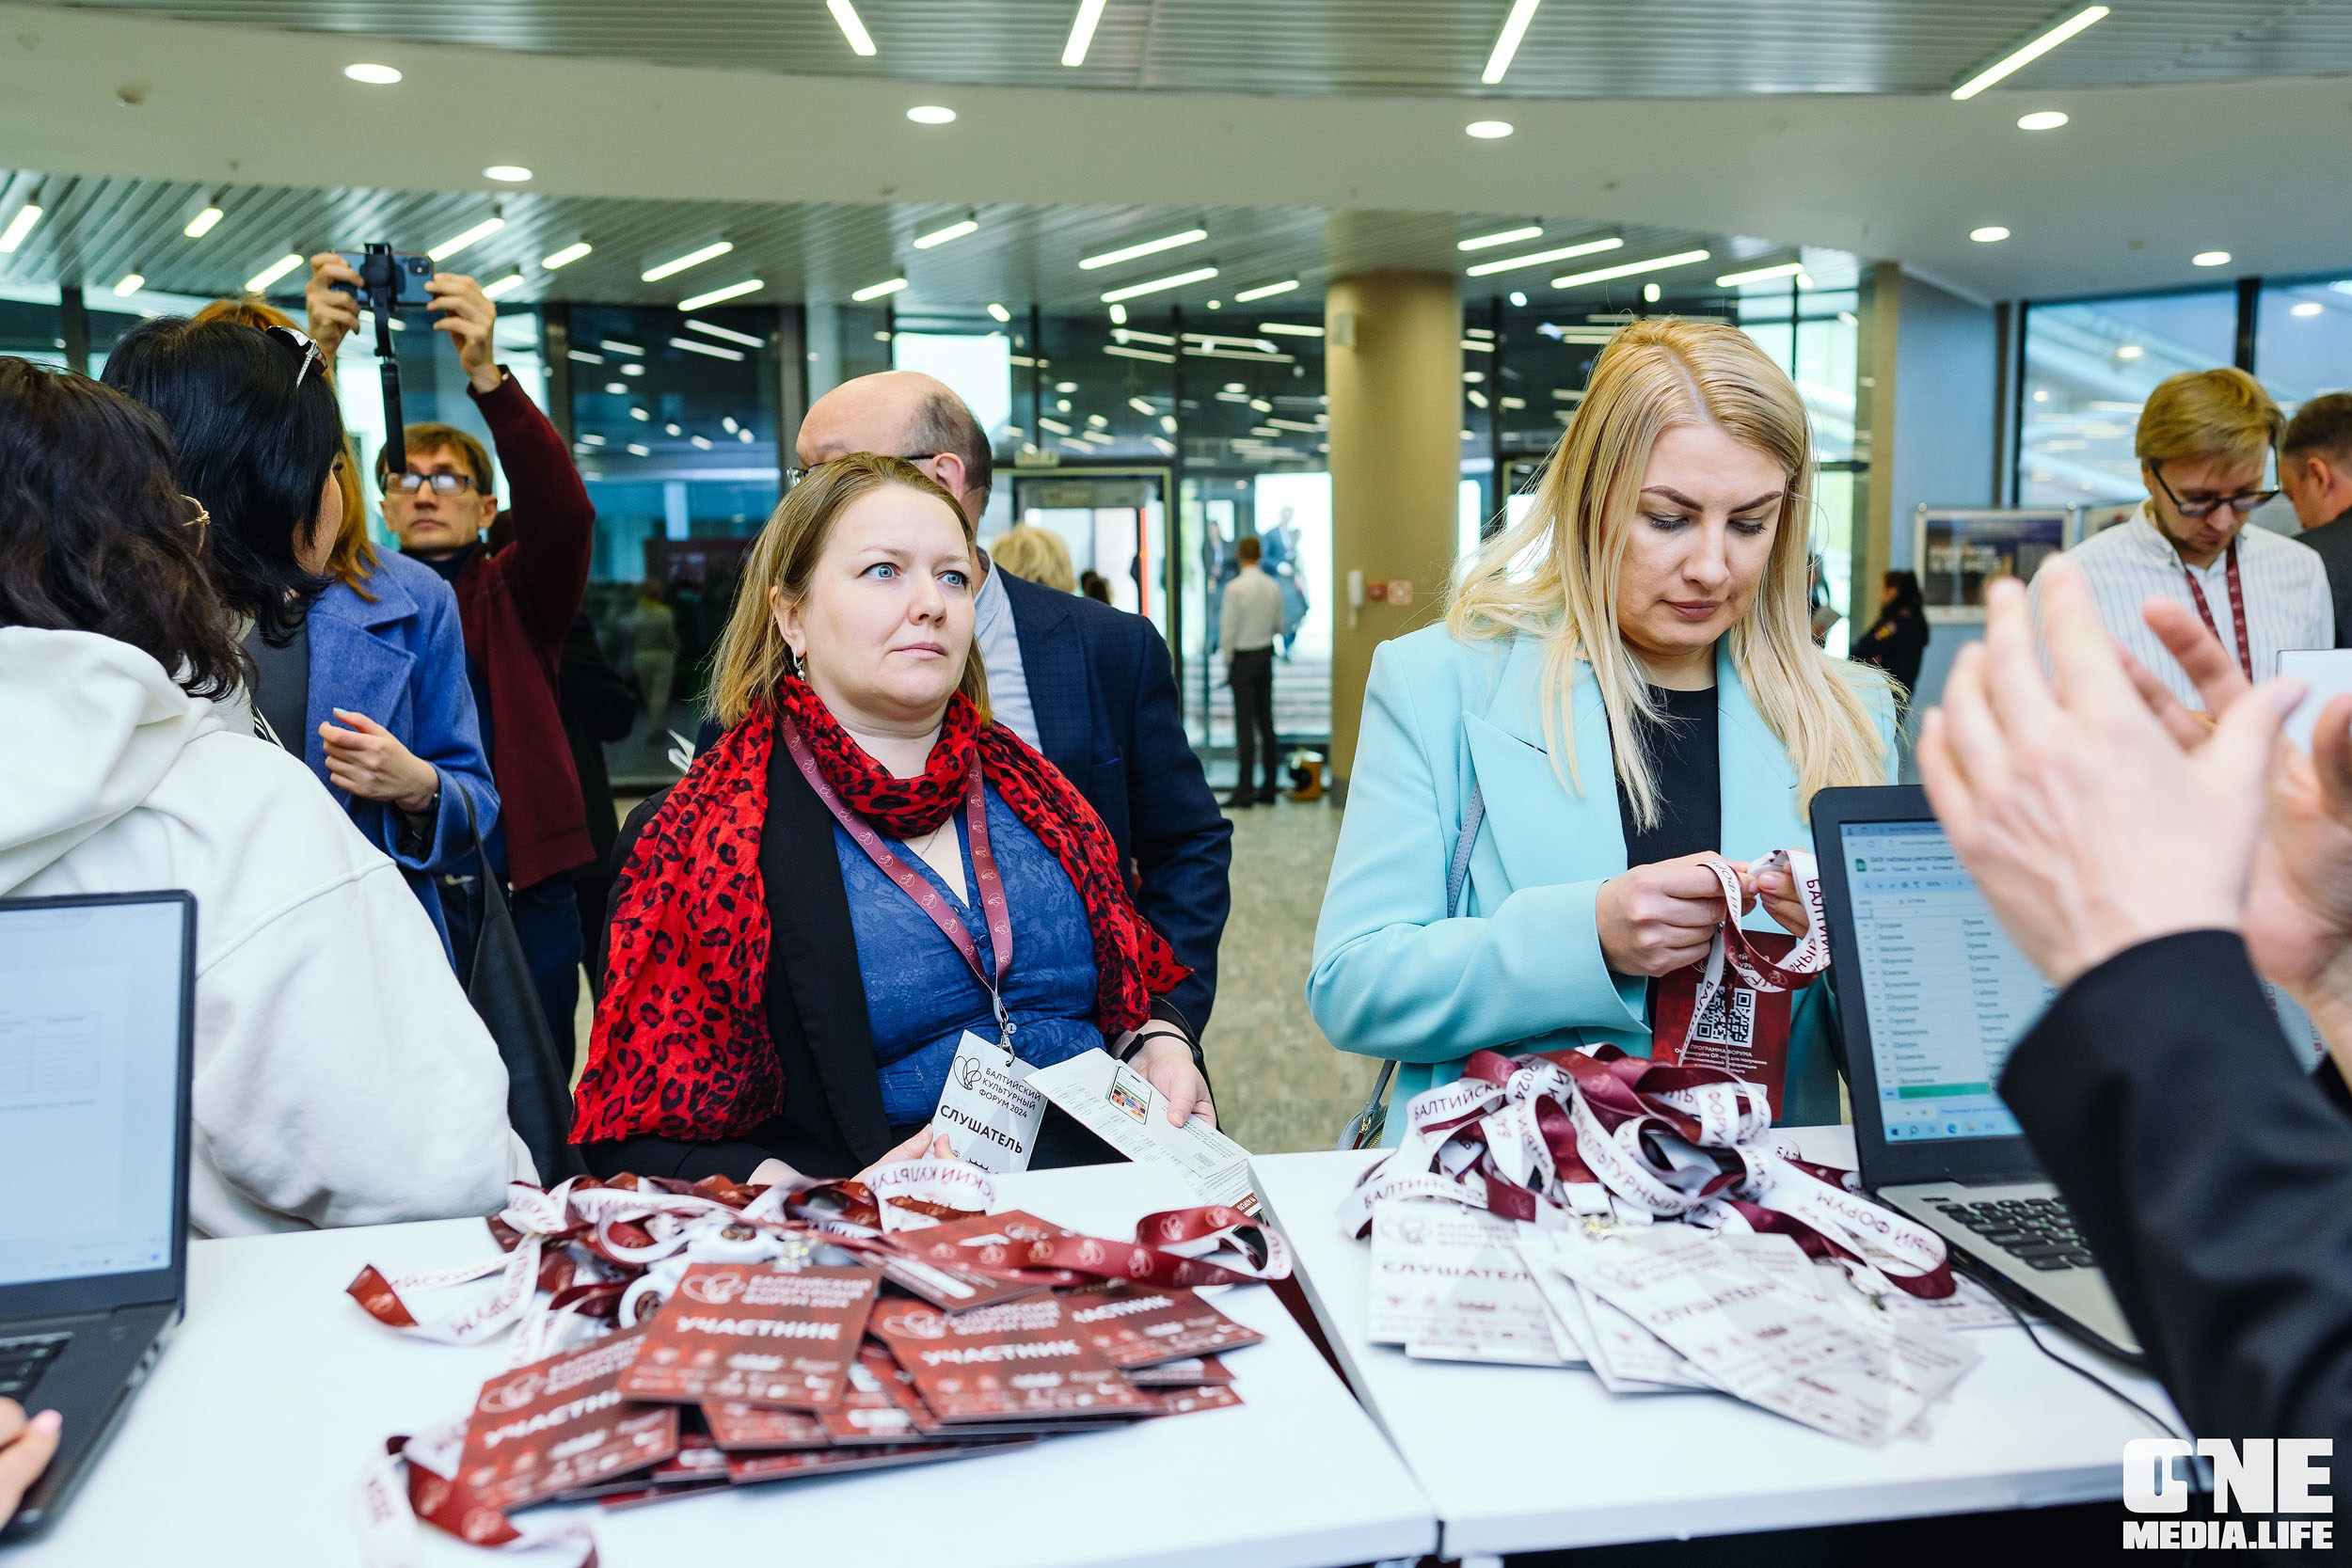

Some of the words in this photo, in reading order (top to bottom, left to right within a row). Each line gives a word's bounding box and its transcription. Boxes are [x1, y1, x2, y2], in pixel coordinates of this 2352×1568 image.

[982, 1078, 1036, 1111] КУЛЬТУРНЫЙ
[985, 1068, 1041, 1101] БАЛТИЙСКИЙ
[1414, 1079, 1502, 1120] БАЛТИЙСК
[978, 1088, 1009, 1109] ФОРУМ
[1009, 1103, 1027, 1118] 2024
[940, 1104, 1024, 1154] СЛУШАТЕЛЬ
[1382, 1260, 1530, 1282] СЛУШАТЕЛ
[1073, 1293, 1174, 1322] ЧАСТНИК
[675, 1316, 842, 1340] УЧАСТНИК
[919, 1338, 1081, 1367] УЧАСТНИК
[484, 1388, 623, 1449] УЧАСТНИ
